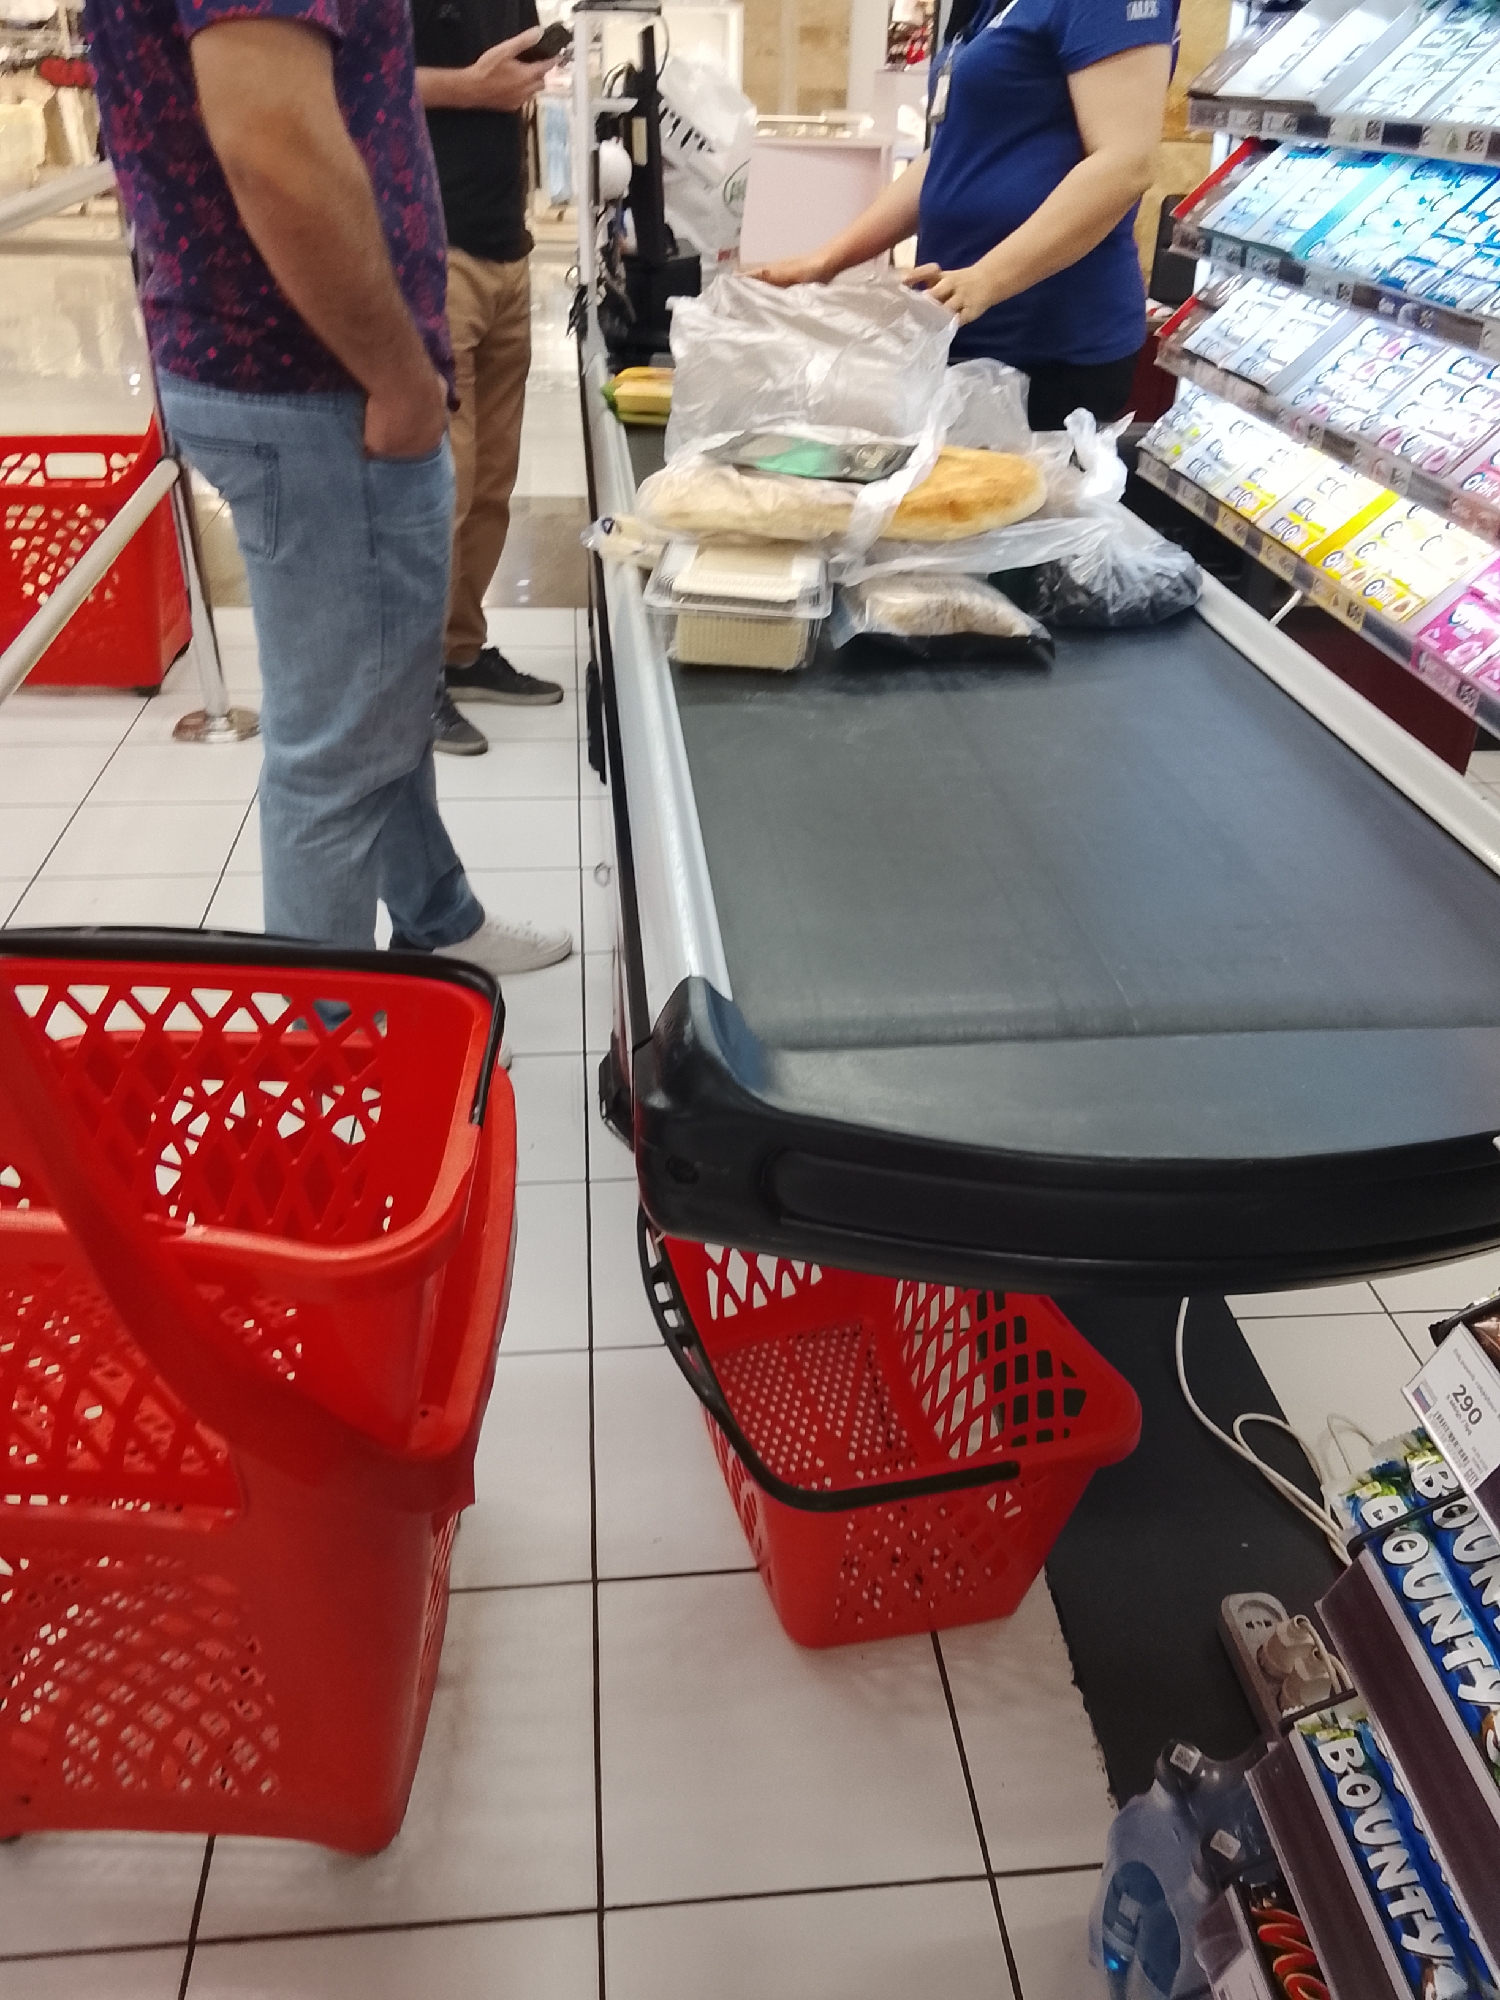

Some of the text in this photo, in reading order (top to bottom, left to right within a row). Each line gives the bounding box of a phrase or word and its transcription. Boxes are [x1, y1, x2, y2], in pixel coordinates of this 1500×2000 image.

[1452, 1384, 1483, 1426] 290
[1360, 1494, 1500, 1707] BOUNTY
[1318, 1736, 1456, 1960] BOUNTY
